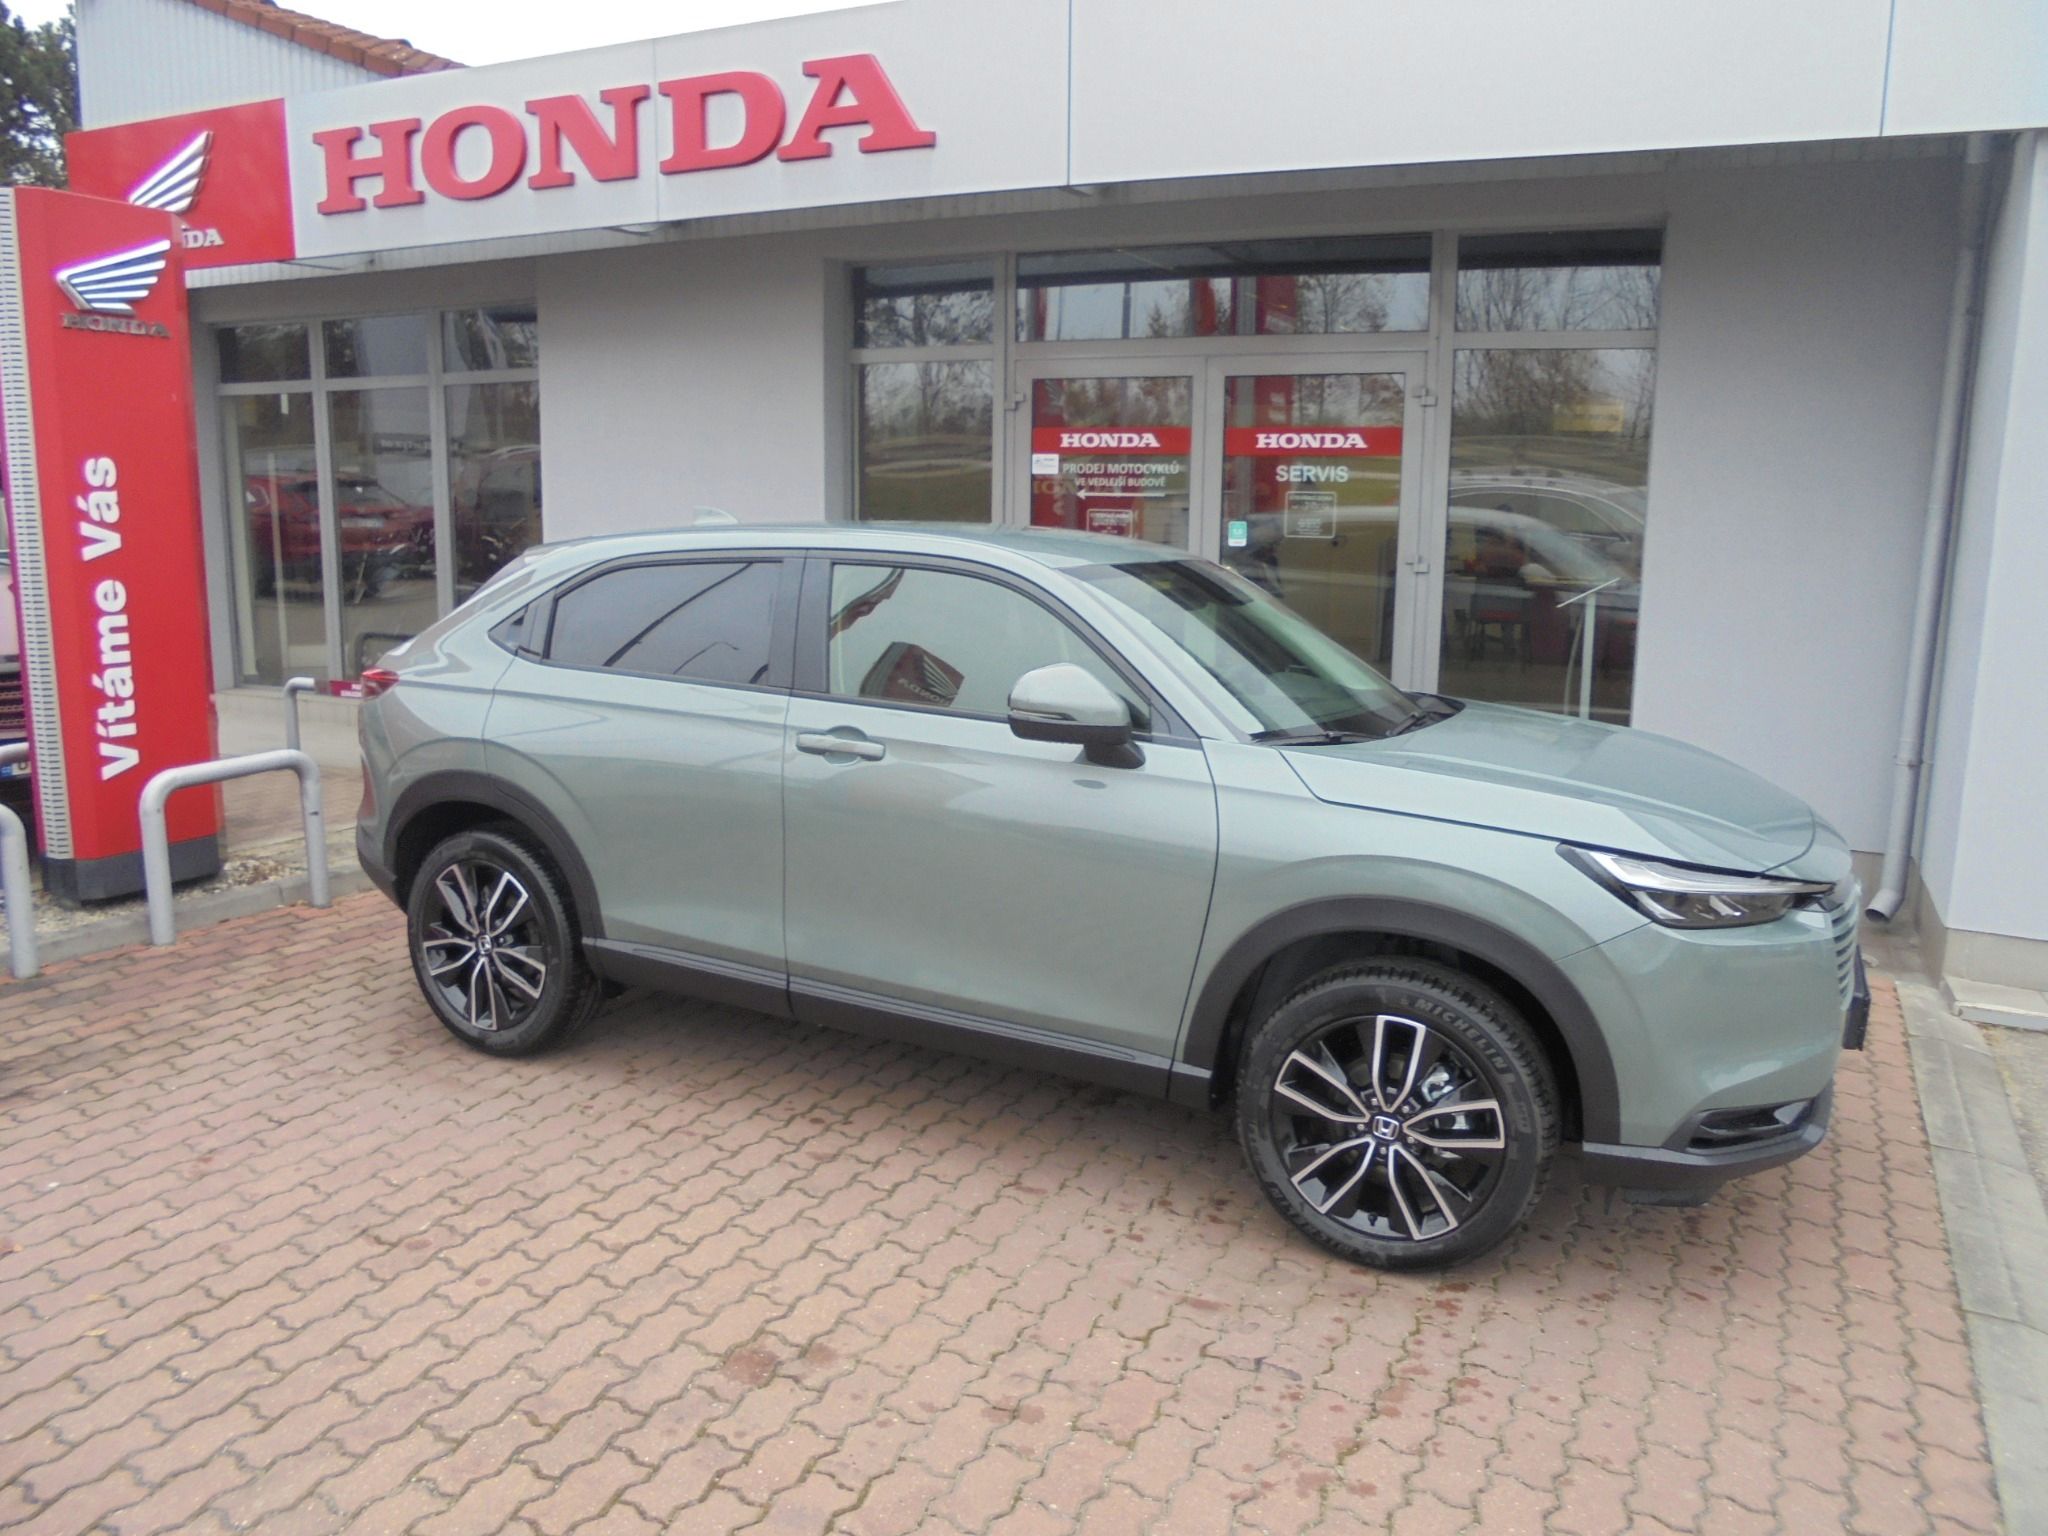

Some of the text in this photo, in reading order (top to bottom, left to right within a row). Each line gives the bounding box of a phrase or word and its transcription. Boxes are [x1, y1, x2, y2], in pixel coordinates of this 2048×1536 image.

[312, 53, 937, 215] HONDA
[62, 313, 170, 338] HONDA
[1060, 433, 1160, 448] HONDA
[1255, 433, 1367, 449] HONDA
[1062, 463, 1105, 475] PRODEJ
[1107, 460, 1180, 475] MOTOCYKLŮ
[1275, 465, 1349, 483] SERVIS
[77, 457, 139, 780] Vítáme Vás
[1414, 999, 1507, 1069] MICHELIN
